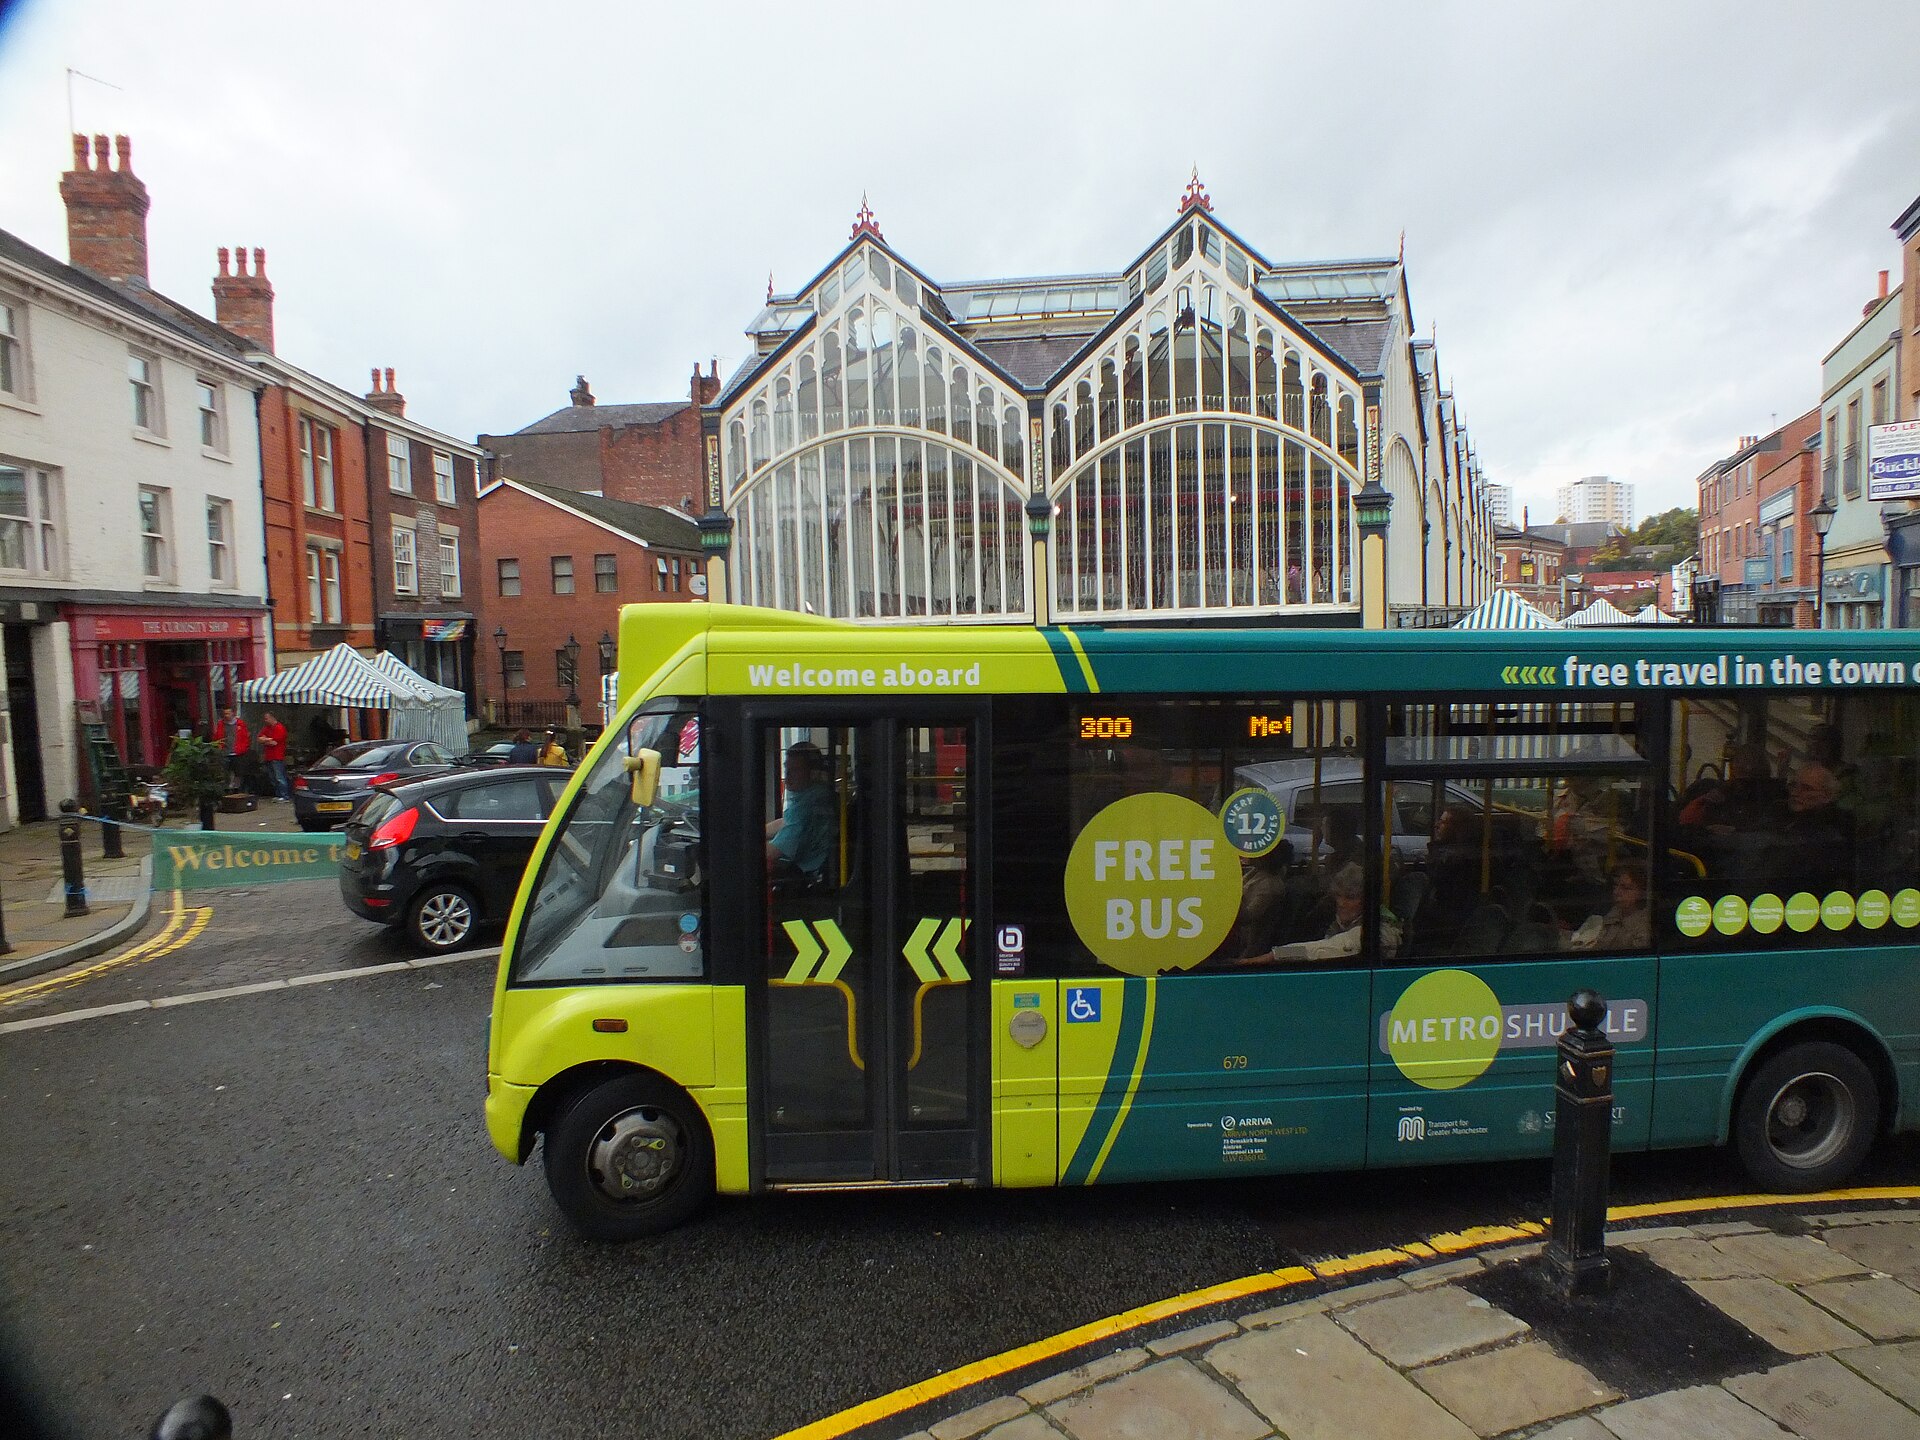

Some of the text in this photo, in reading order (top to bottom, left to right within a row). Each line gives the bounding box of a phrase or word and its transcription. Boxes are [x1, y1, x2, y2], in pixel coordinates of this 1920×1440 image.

[1902, 423, 1920, 431] LE
[142, 621, 161, 633] THE
[162, 621, 207, 633] CURIOSITY
[208, 621, 228, 633] SHOP
[748, 662, 980, 687] Welcome aboard
[1564, 655, 1628, 686] free
[1635, 655, 1728, 686] travel
[1735, 656, 1763, 685] in
[1770, 654, 1823, 685] the
[1827, 658, 1905, 685] town
[1081, 717, 1132, 738] 300
[1227, 796, 1253, 824] EVERY
[1237, 812, 1267, 835] 12
[1243, 814, 1278, 850] MINUTES
[168, 845, 319, 871] Welcome
[1094, 839, 1215, 881] FREE
[1106, 897, 1204, 940] BUS
[1223, 1055, 1248, 1070] 679
[1239, 1117, 1273, 1127] ARRIVA
[1427, 1127, 1488, 1137] Greater Manchester
[1428, 1118, 1468, 1128] Transport for
